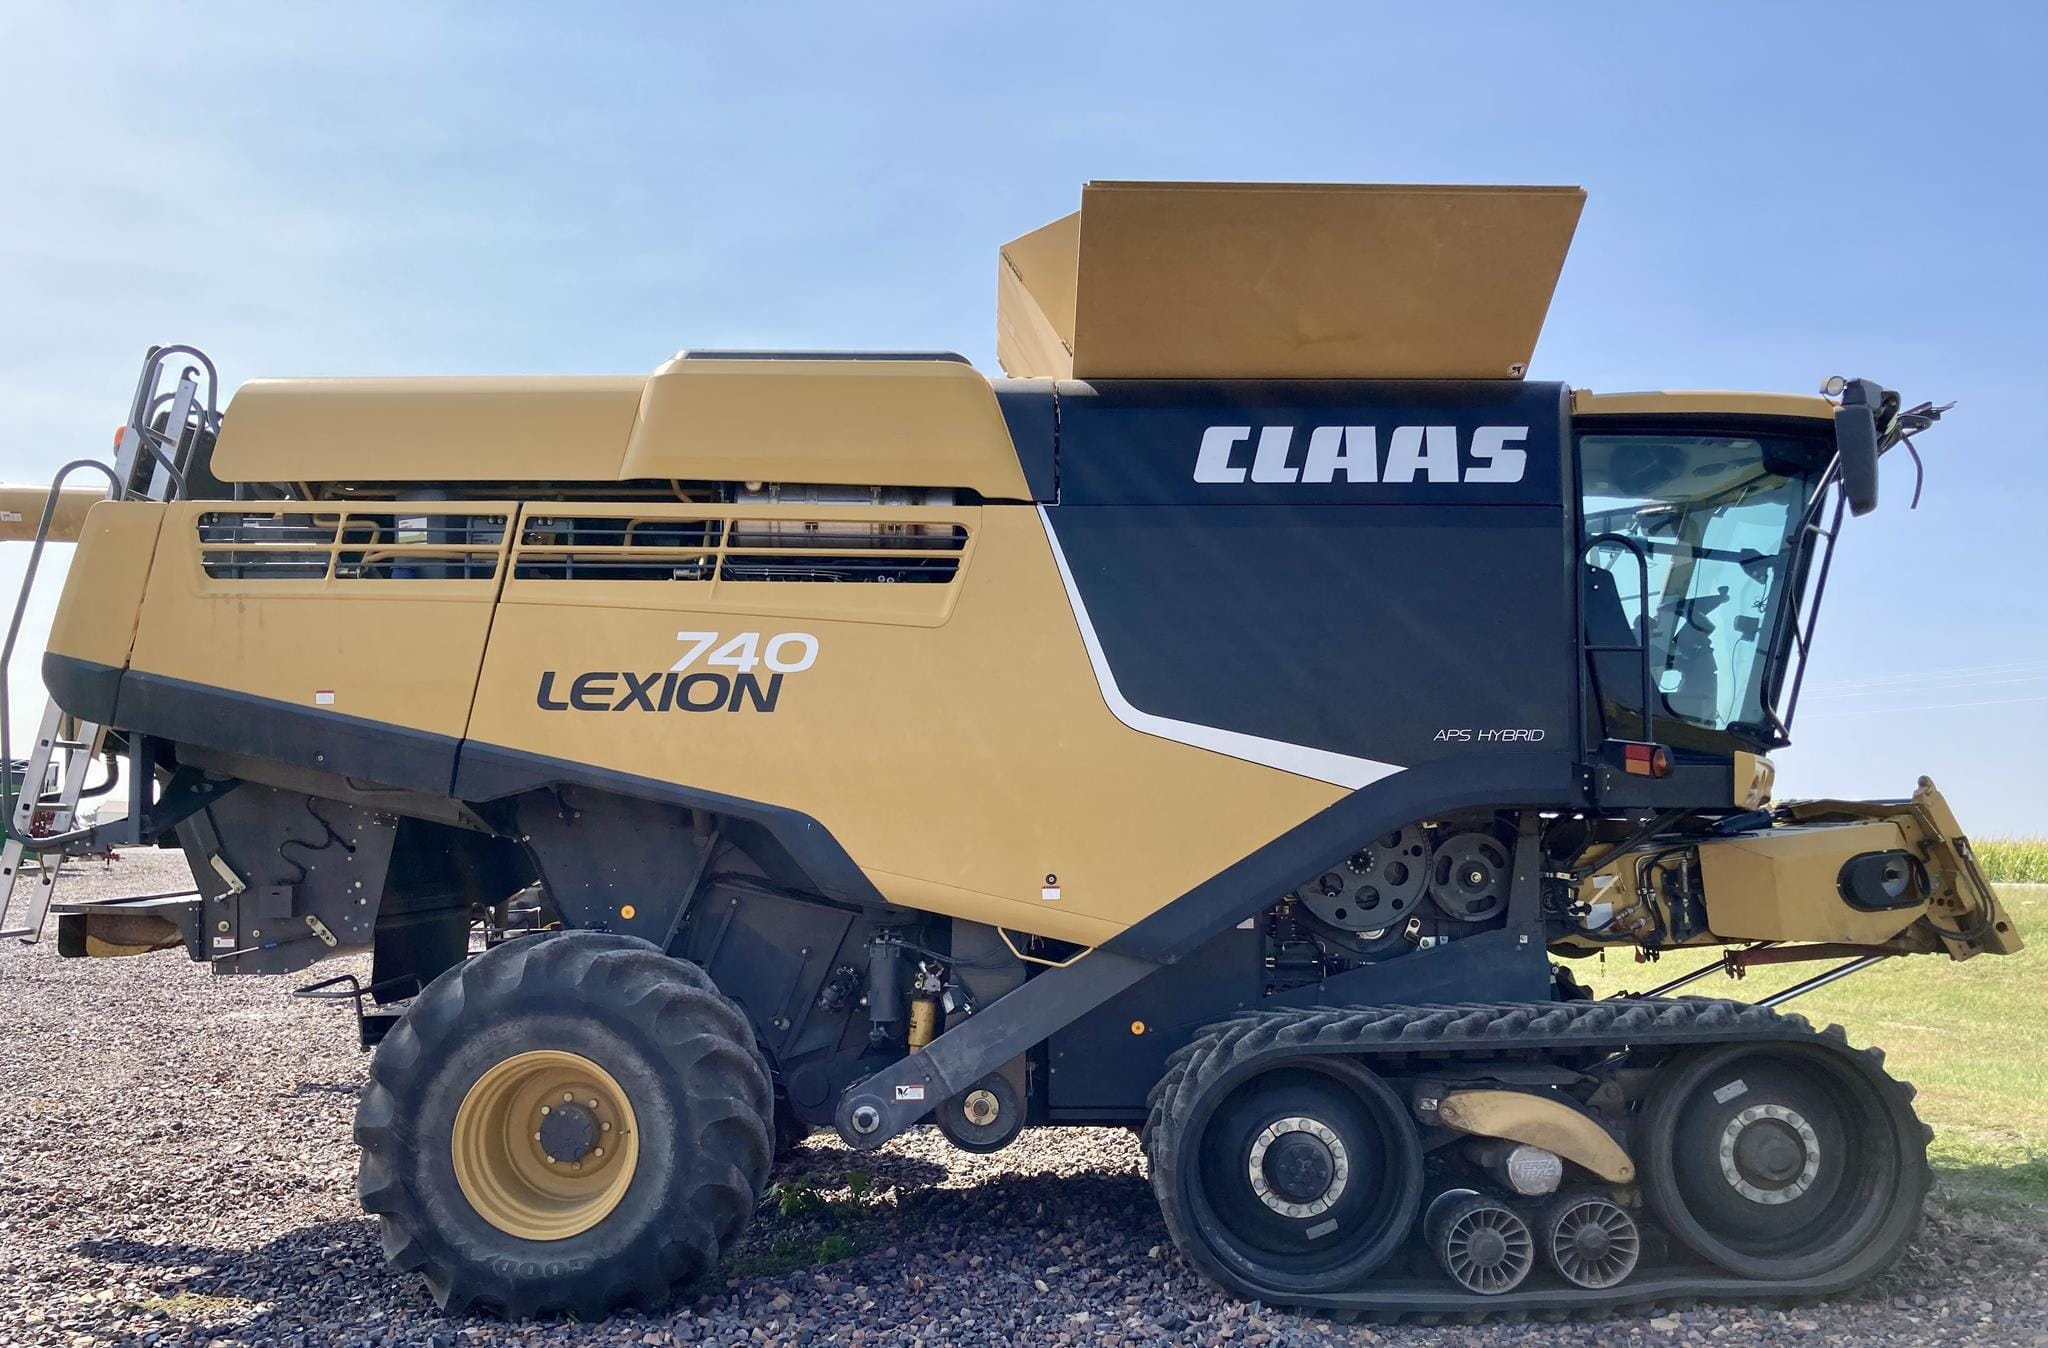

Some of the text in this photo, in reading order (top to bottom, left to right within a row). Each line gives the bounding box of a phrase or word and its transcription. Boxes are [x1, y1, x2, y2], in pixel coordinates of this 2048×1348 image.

[1193, 426, 1529, 483] CLAAS
[670, 631, 819, 673] 740
[536, 671, 784, 713] LEXION
[1432, 729, 1545, 742] APS HYBRID
